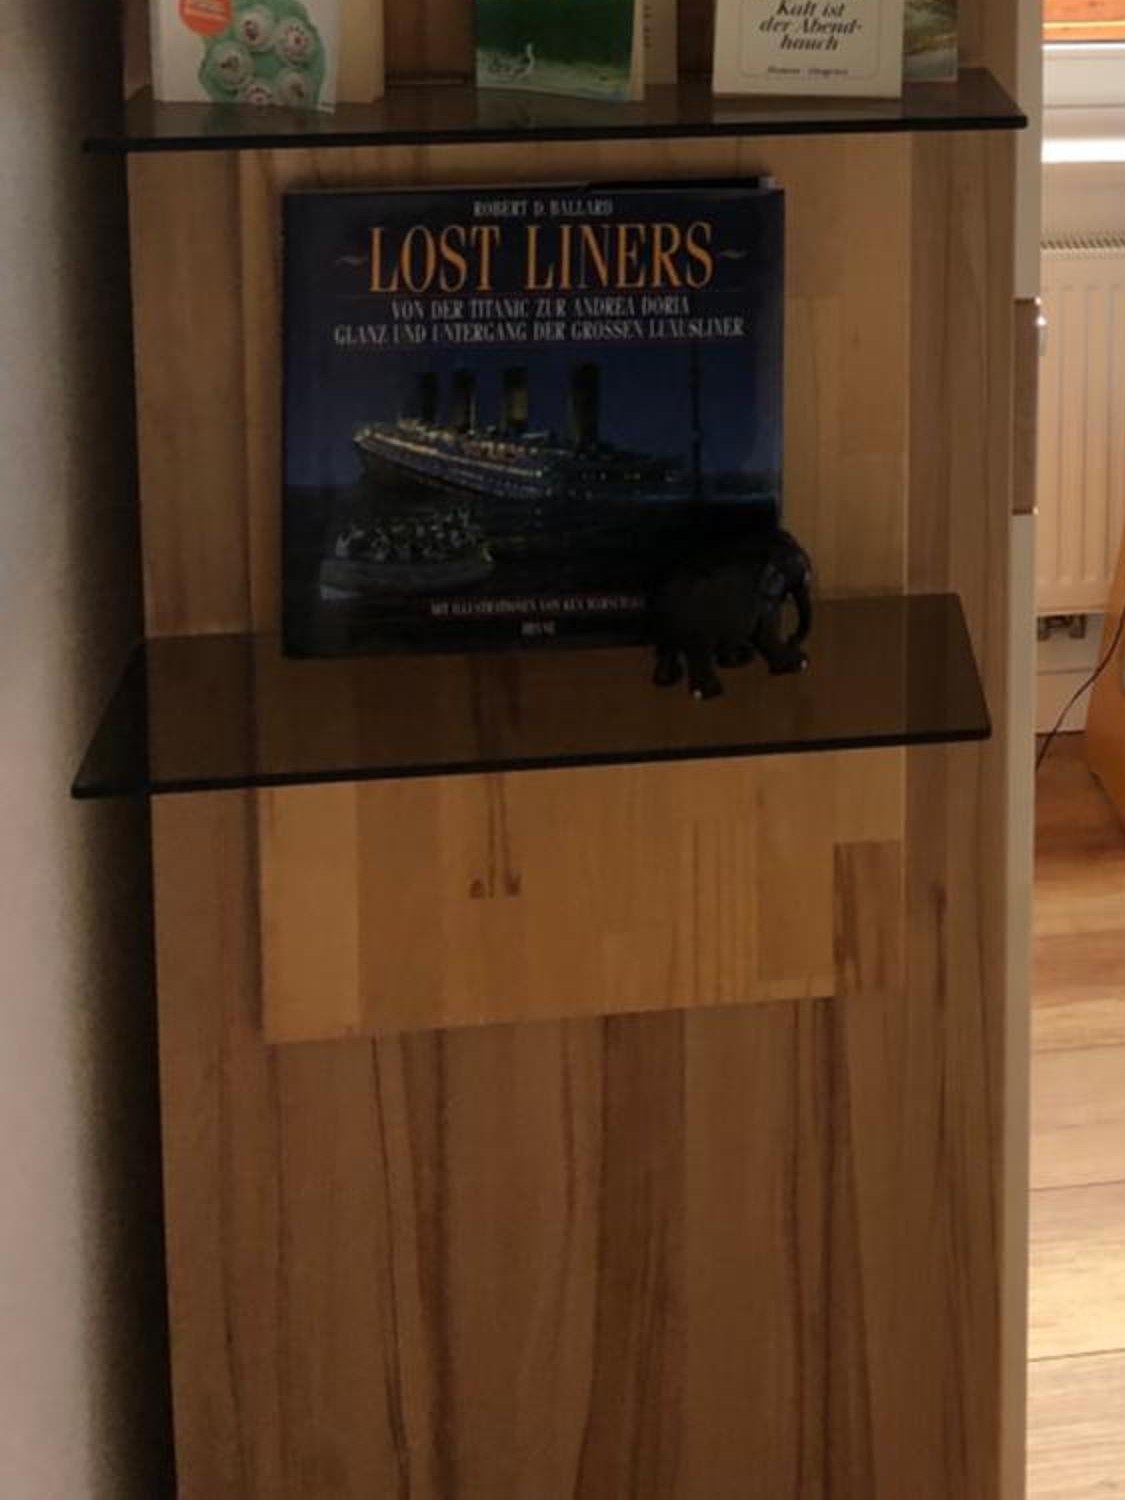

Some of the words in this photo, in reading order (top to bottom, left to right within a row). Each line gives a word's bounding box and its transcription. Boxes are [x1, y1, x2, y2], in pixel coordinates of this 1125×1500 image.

[776, 0, 817, 16] Kalt
[822, 2, 845, 17] ist
[759, 17, 791, 32] der
[780, 34, 839, 51] hauch
[473, 200, 527, 217] ROBERT
[549, 198, 614, 217] BALLARD
[369, 223, 502, 294] LOST
[525, 219, 716, 291] LINERS
[391, 299, 426, 320] VON
[431, 299, 465, 320] DER
[468, 298, 529, 320] TITANIC
[535, 297, 567, 320] ZUR
[574, 296, 636, 318] ANDREA
[641, 295, 691, 316] DORIA
[335, 323, 387, 345] GLANZ
[393, 323, 427, 344] UND
[432, 321, 527, 342] UNTERGANG
[533, 321, 566, 341] DER
[571, 320, 644, 341] GROSSEN
[649, 316, 745, 339] LUXUSLINER
